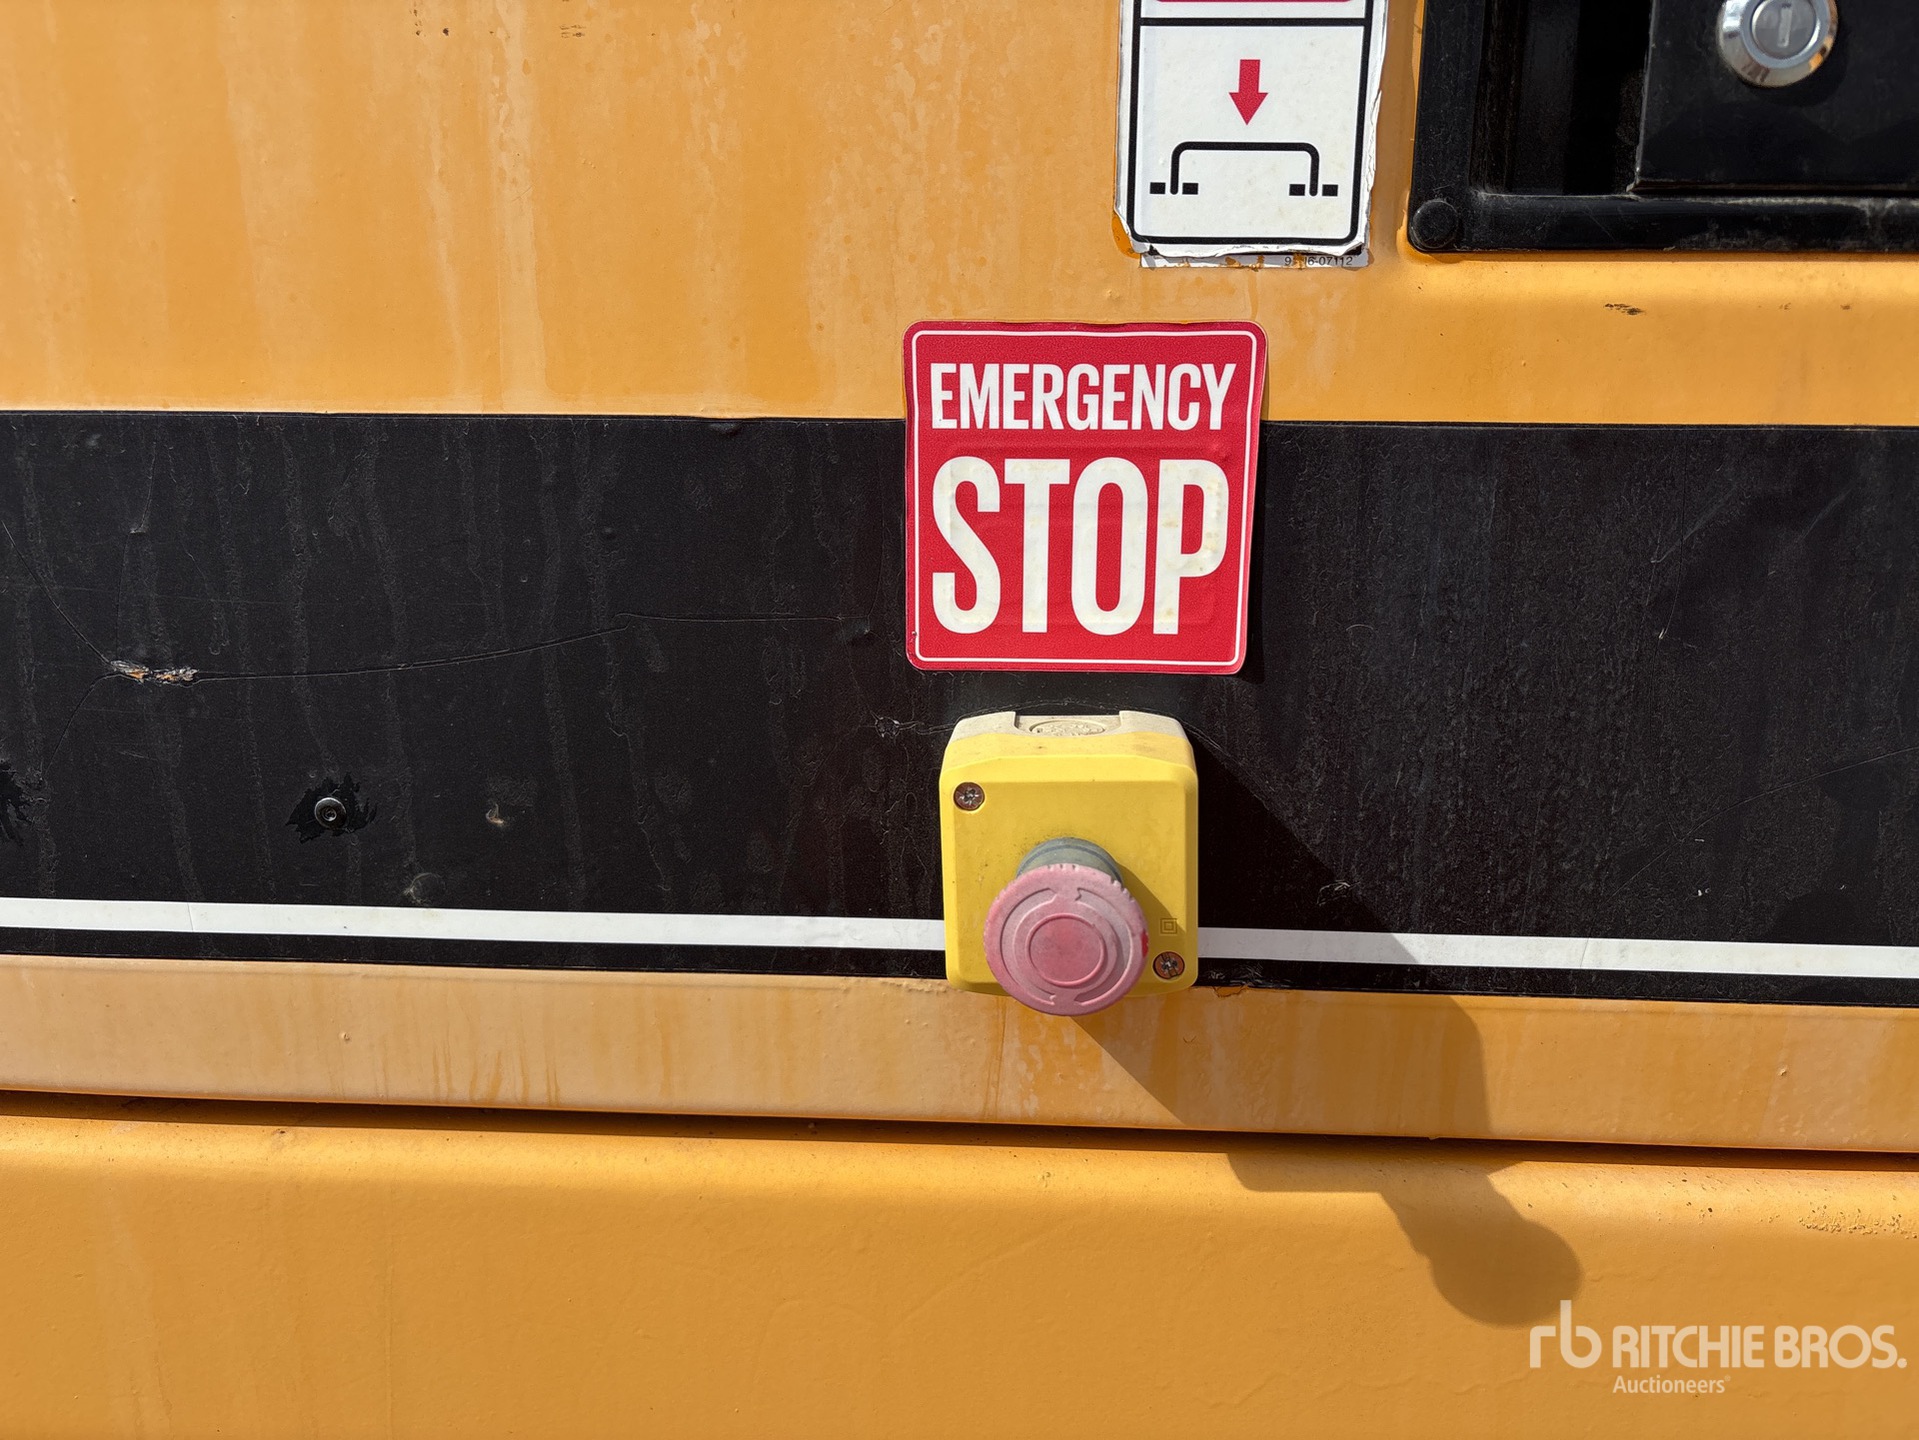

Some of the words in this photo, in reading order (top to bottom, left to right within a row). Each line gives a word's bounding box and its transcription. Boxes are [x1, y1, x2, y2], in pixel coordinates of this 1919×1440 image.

[1284, 256, 1353, 266] 96-07112
[930, 363, 1237, 431] EMERGENCY
[932, 456, 1230, 636] STOP
